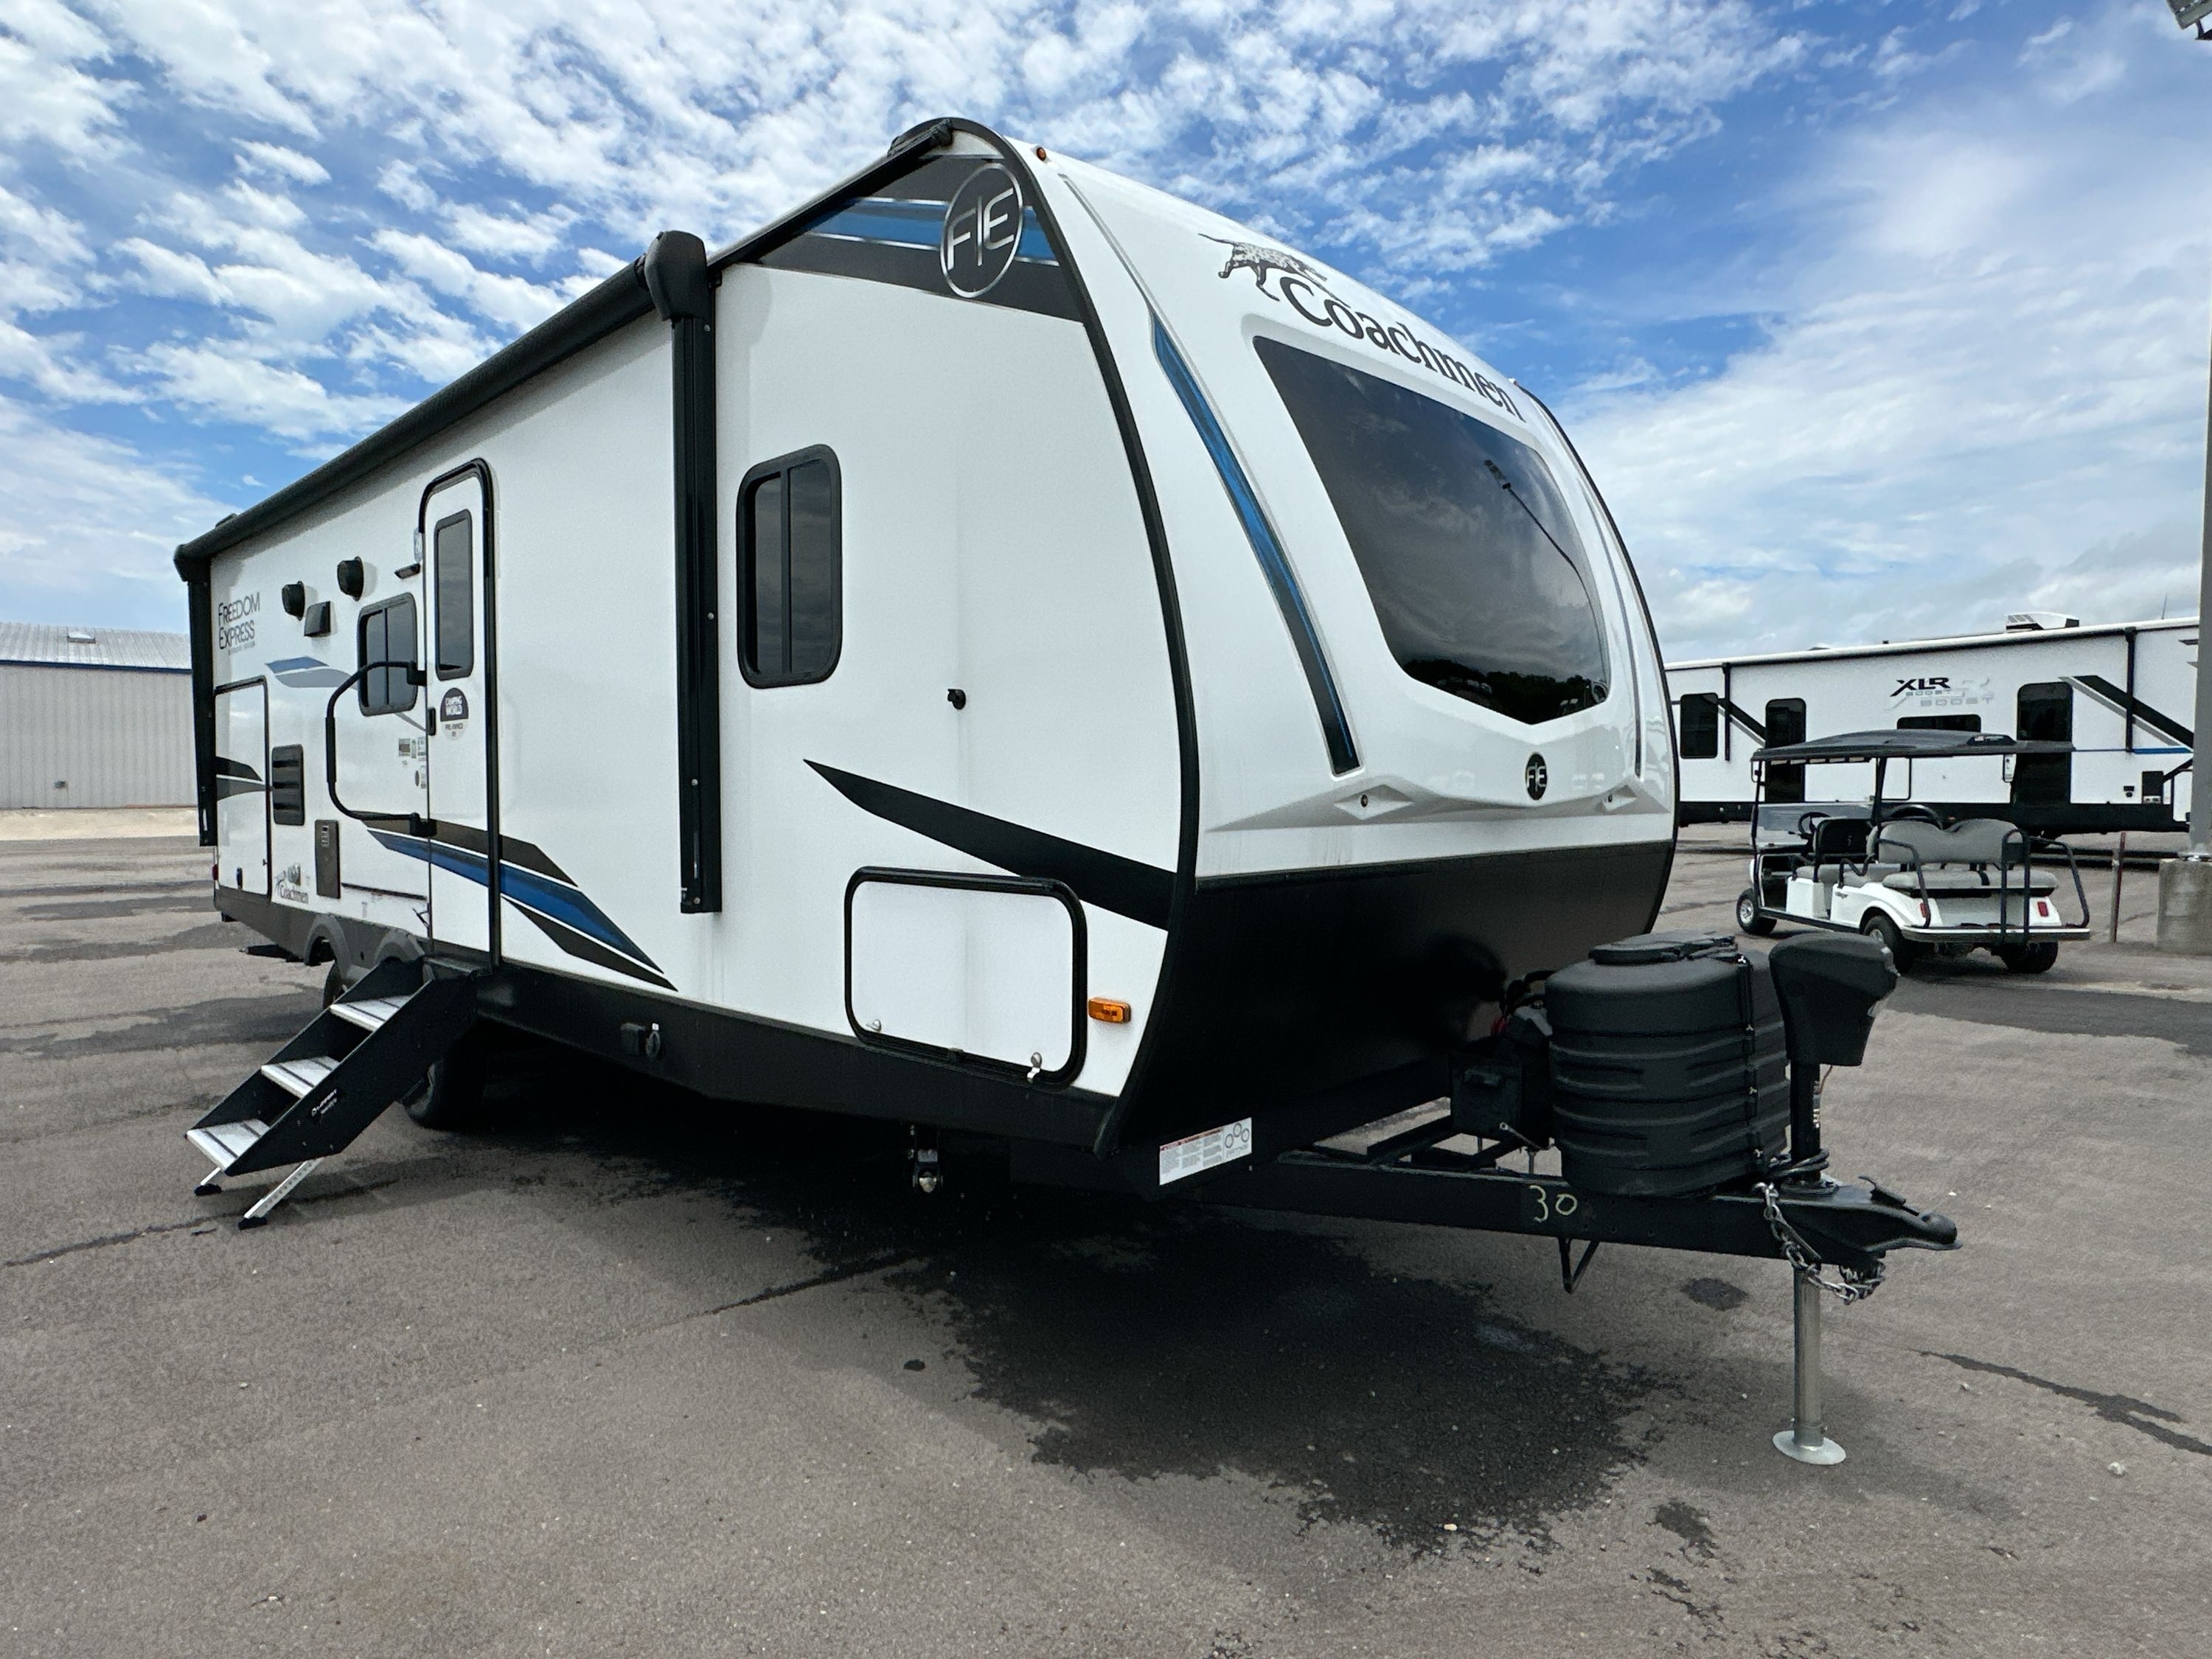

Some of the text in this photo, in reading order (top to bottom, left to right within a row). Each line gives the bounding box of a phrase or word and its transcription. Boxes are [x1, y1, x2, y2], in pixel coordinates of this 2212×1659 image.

[1279, 276, 1526, 422] Coachmen
[218, 591, 260, 626] FREEDOM
[218, 619, 255, 650] EXPRESS
[1890, 677, 1951, 697] XLR
[1529, 1185, 1578, 1223] 30
